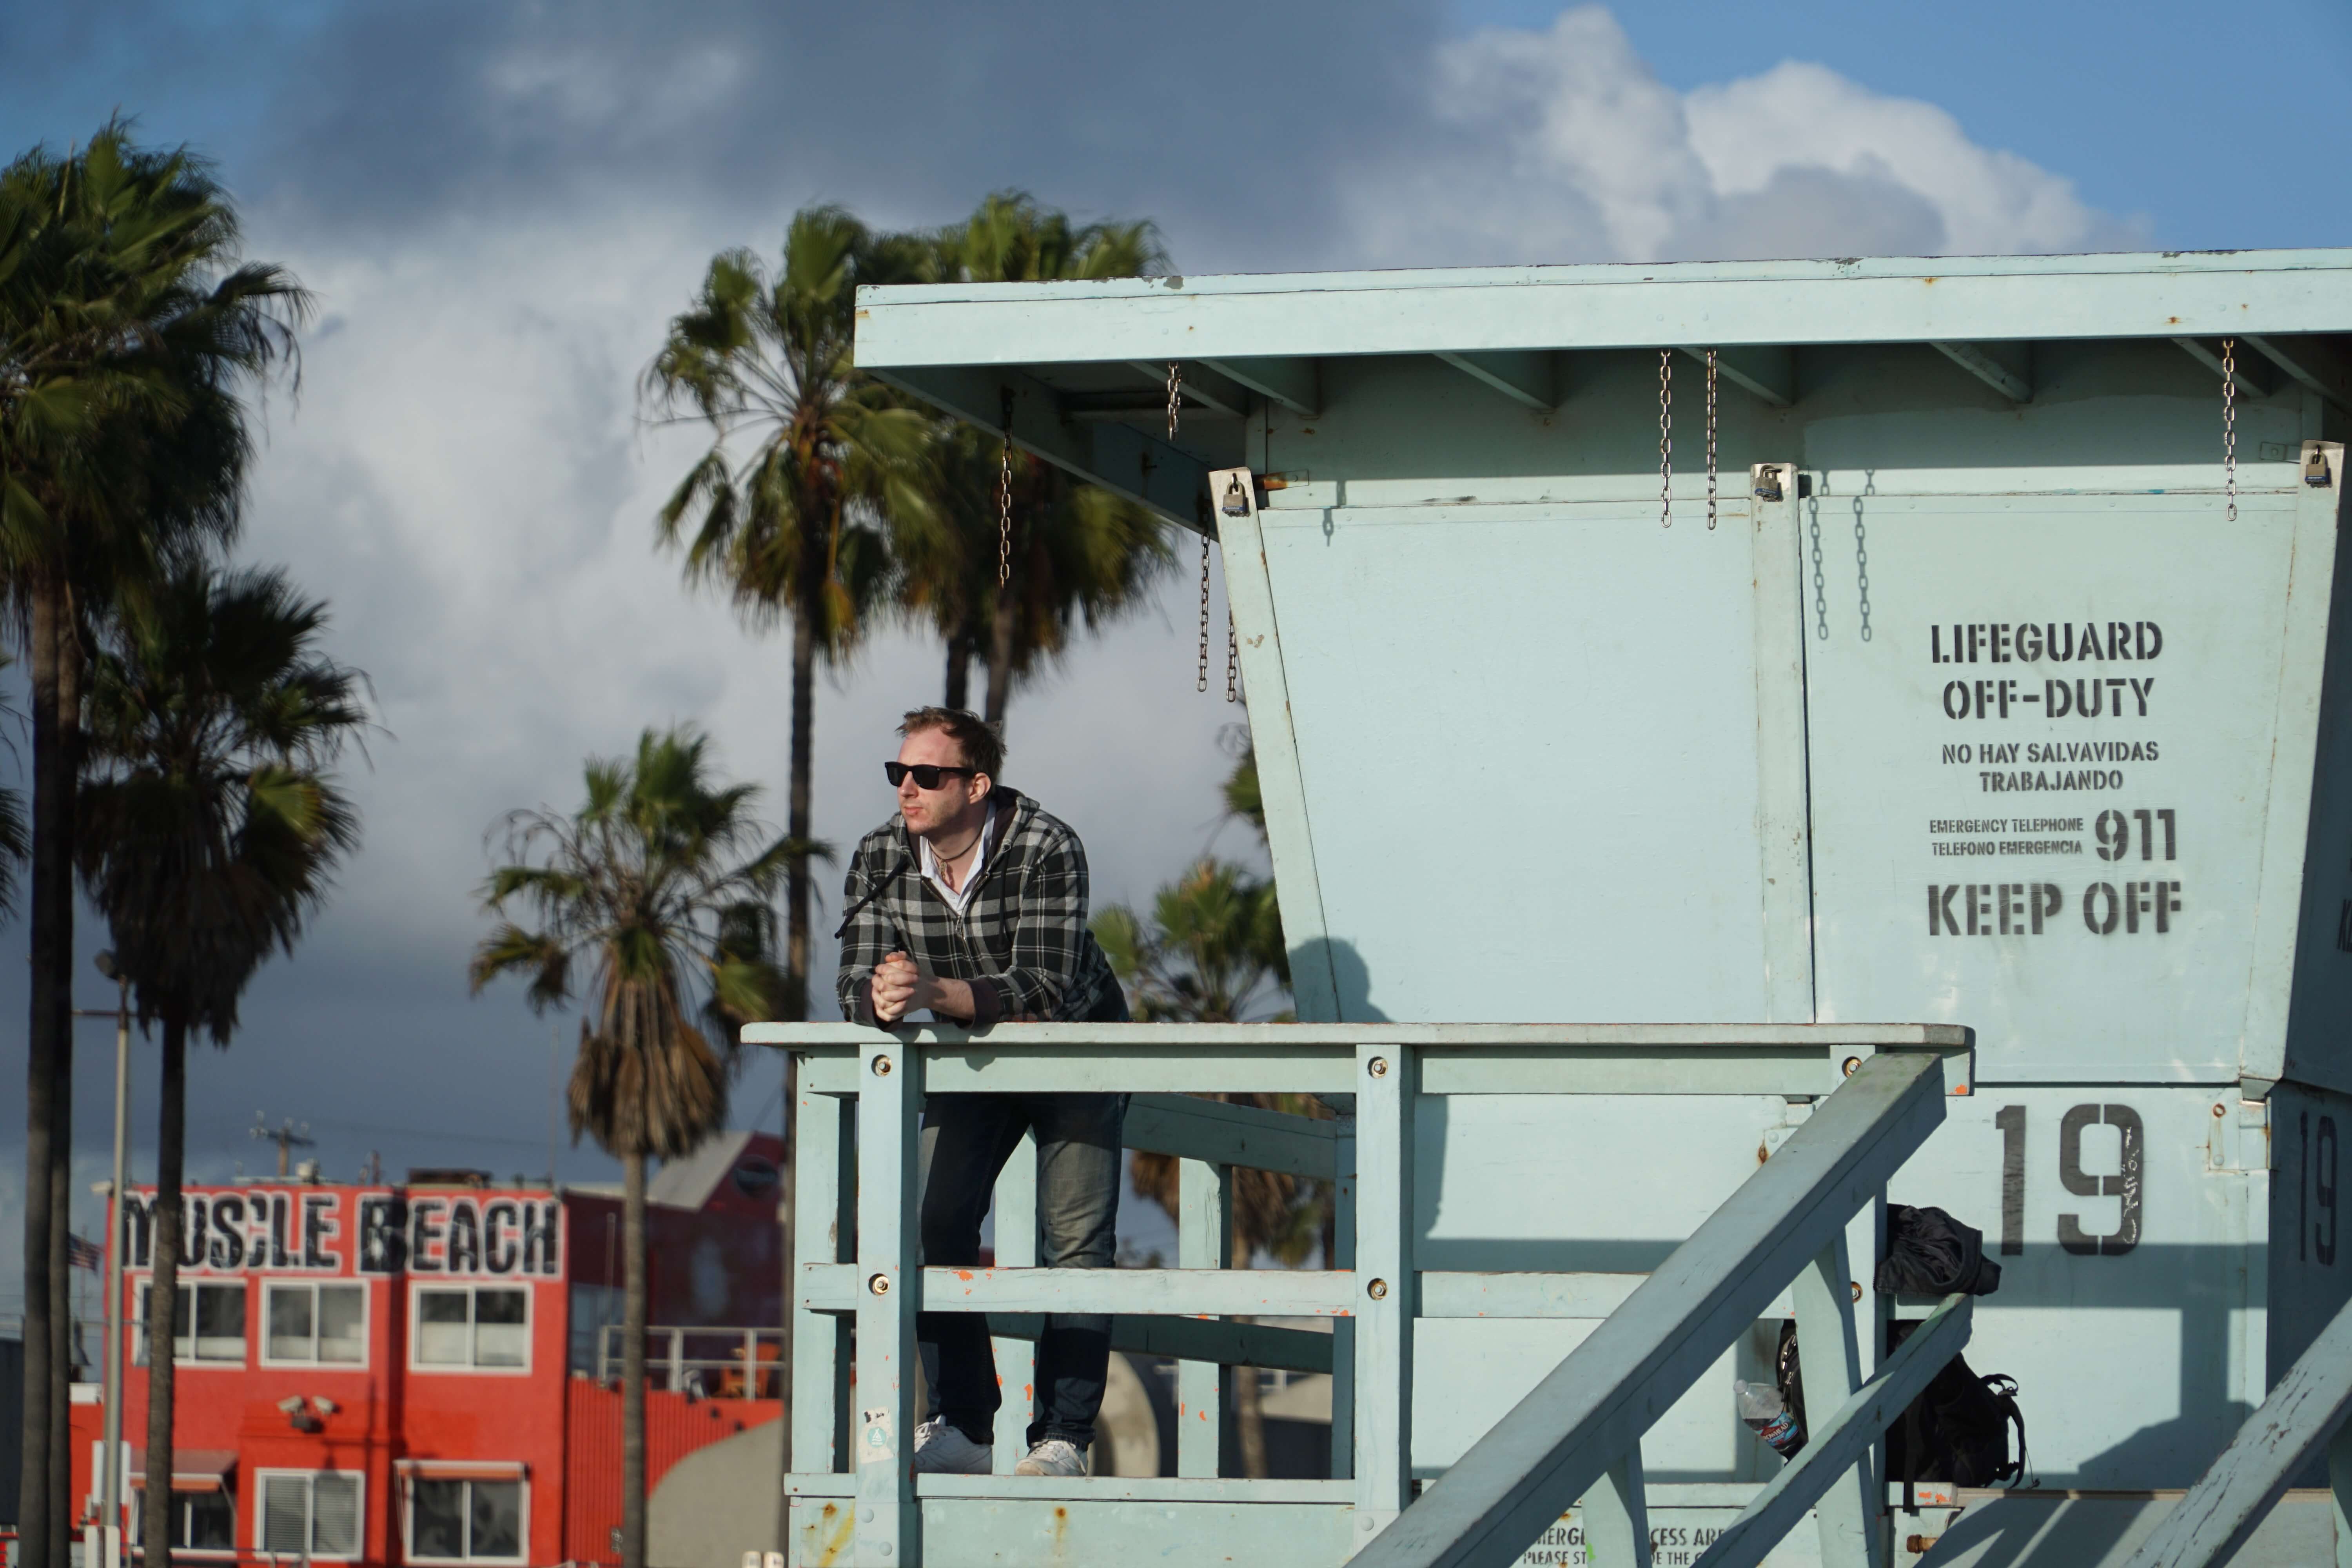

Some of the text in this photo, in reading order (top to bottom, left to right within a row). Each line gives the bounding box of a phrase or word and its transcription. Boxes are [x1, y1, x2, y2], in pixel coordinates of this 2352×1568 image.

[1931, 621, 2163, 663] LIFEGUARD
[1943, 677, 2154, 720] OFF-DUTY
[1942, 740, 2159, 764] NO HAY SALVAVIDAS
[1979, 769, 2123, 793] TRABAJANDO
[1929, 817, 2084, 834] EMERGENCY TELEPHONE
[2095, 808, 2176, 862] 911
[1931, 840, 2082, 856] TELEFONO EMERGENCIA
[1927, 881, 2182, 936] KEEP OFF
[1996, 1103, 2143, 1256] 19
[2300, 1111, 2337, 1266] 19
[121, 1192, 561, 1277] MUSCLE BEACH
[1523, 1550, 1568, 1565] PLEASE
[1667, 1552, 1690, 1565] THE
